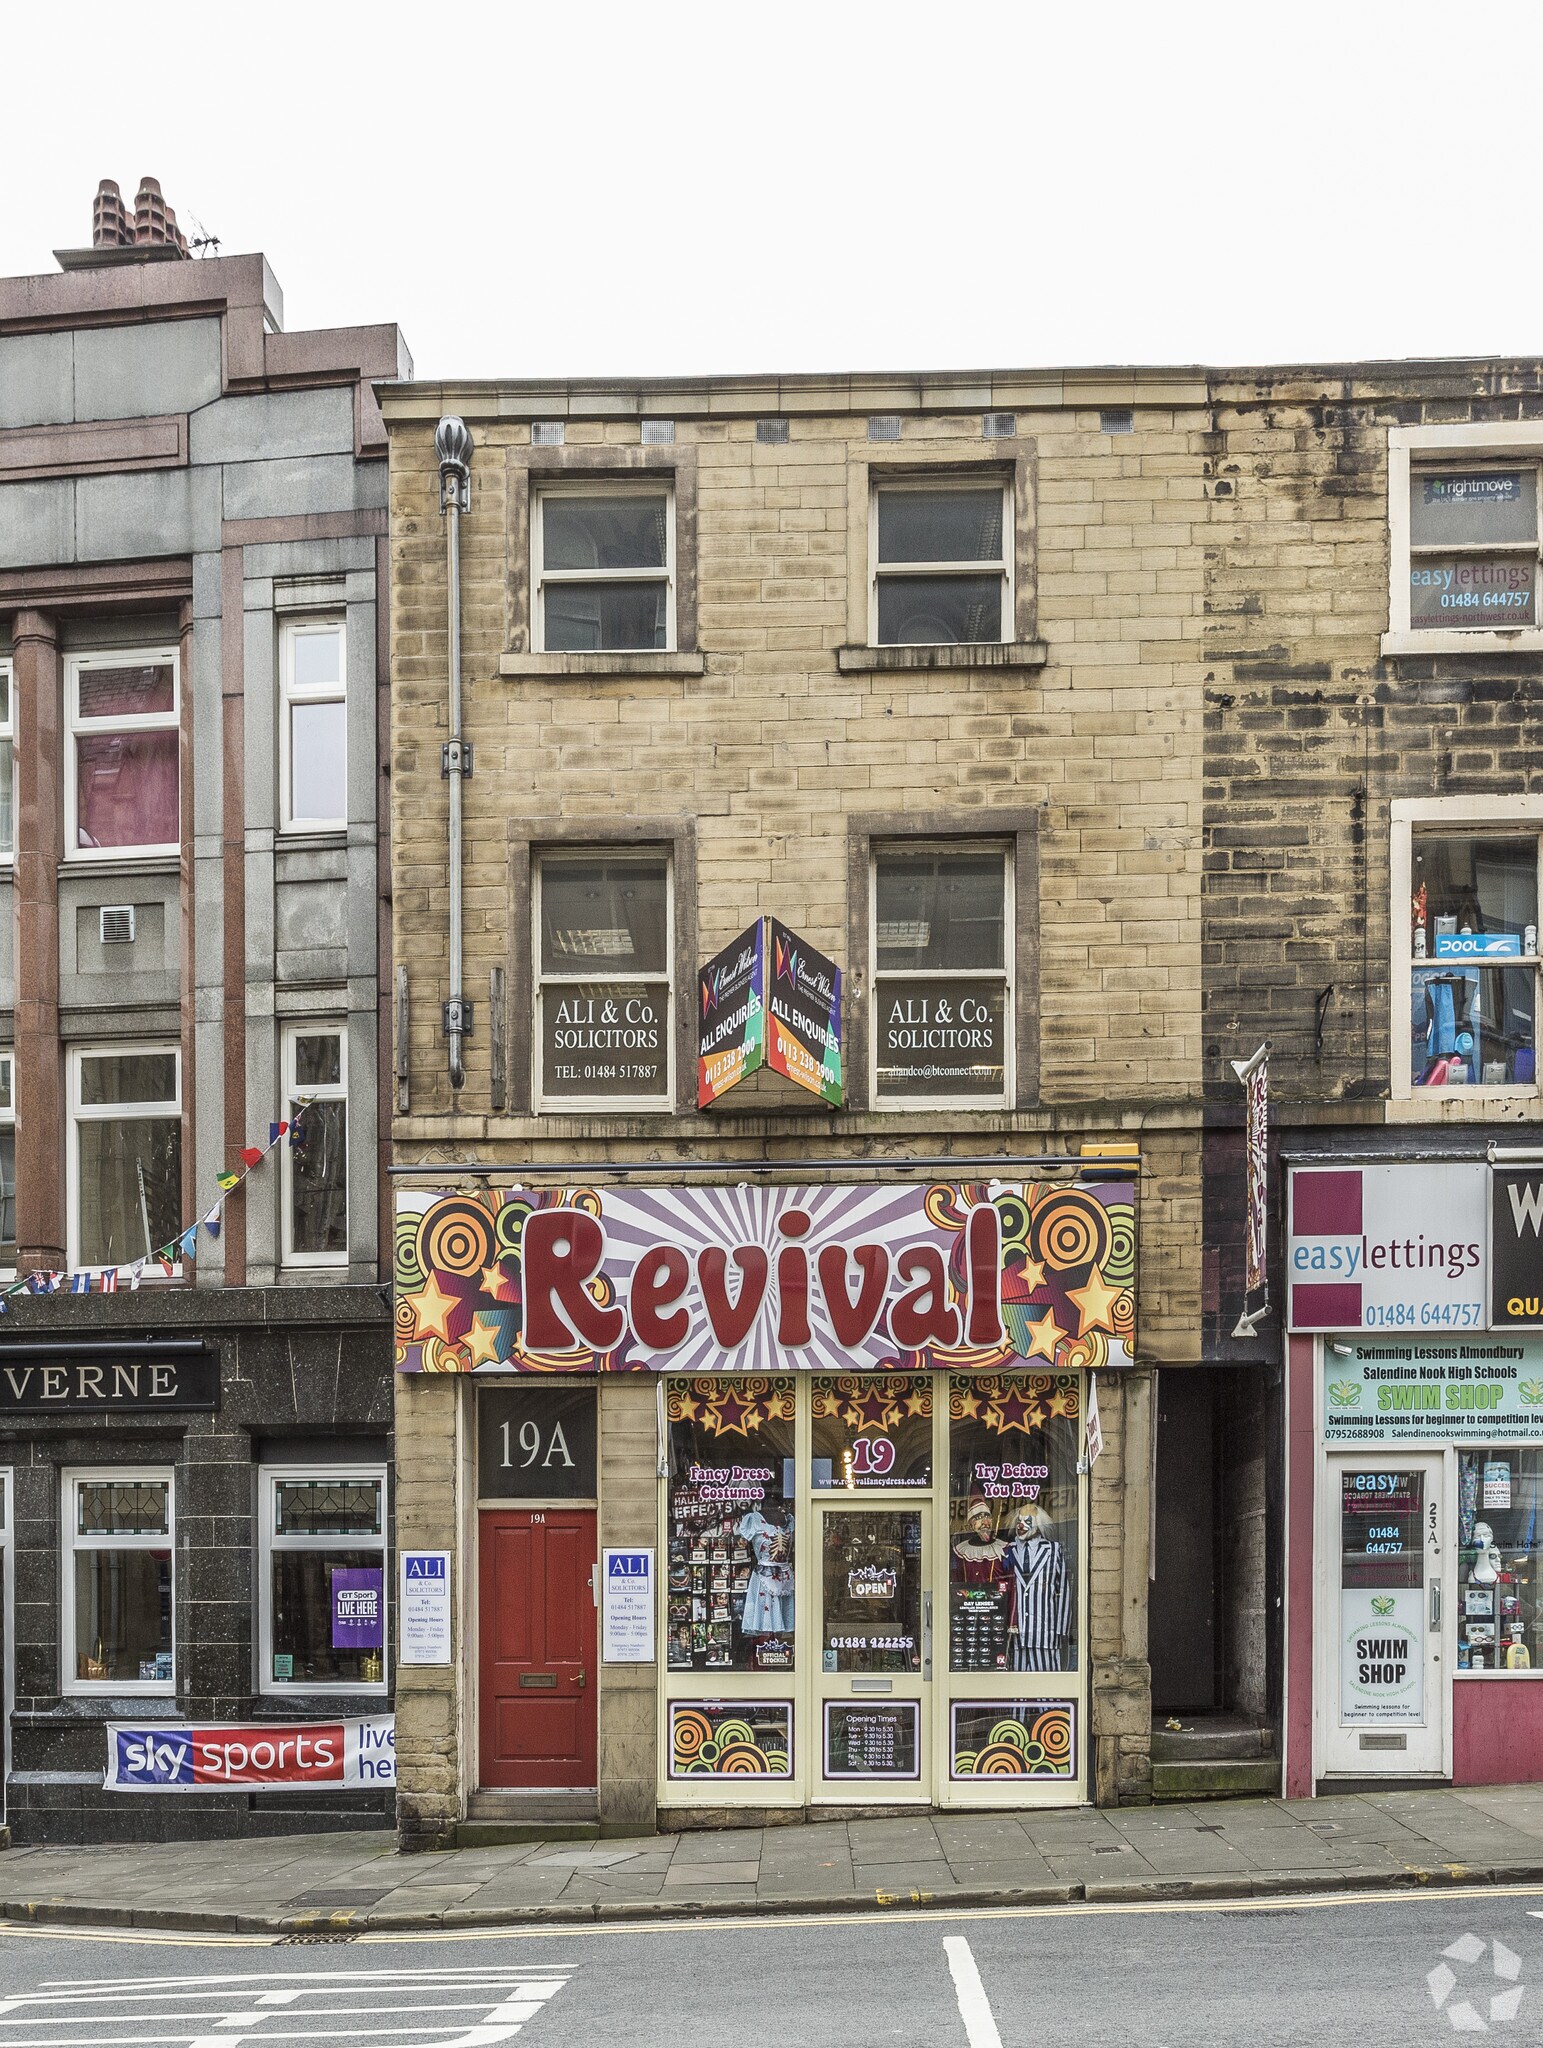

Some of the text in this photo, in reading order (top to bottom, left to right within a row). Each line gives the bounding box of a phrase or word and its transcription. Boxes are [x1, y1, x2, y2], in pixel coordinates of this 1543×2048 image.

[1447, 479, 1512, 497] rightmove
[1411, 563, 1530, 590] easylettings
[1441, 591, 1530, 608] 01484 644757
[1440, 940, 1484, 953] POOL
[797, 957, 836, 1003] Ernest Wilson
[555, 999, 658, 1024] ALI & Co.
[888, 998, 993, 1024] ALI & Co.
[700, 995, 762, 1056] ALL ENQUIRIES
[771, 997, 840, 1054] ALL ENQUIRIES
[554, 1029, 658, 1049] SOLICITORS
[888, 1029, 993, 1048] SOLICITORS
[705, 1036, 755, 1085] 0113 238 2900
[777, 1036, 835, 1085] 0113 238 2900
[554, 1065, 658, 1079] TEL: 01484 517887
[888, 1064, 992, 1080] aliandco@btconnect.com
[1293, 1234, 1480, 1279] easylettings
[523, 1204, 1005, 1351] Revival
[1366, 1303, 1481, 1327] 01484 644757
[1507, 1297, 1543, 1316] QU
[1356, 1346, 1524, 1361] Swimming Lessons Almondbury
[1363, 1365, 1517, 1380] Salendine Nook High Schools
[3, 1365, 178, 1399] VERNE
[1377, 1384, 1504, 1411] SWIM SHOP
[1328, 1415, 1373, 1426] Swimming
[1375, 1415, 1411, 1425] Lessons
[1411, 1415, 1424, 1425] for
[1426, 1414, 1465, 1425] beginner
[1466, 1415, 1475, 1424] to
[1477, 1413, 1530, 1425] competition
[1325, 1429, 1385, 1439] 07952688908
[500, 1420, 576, 1468] 19A
[852, 1438, 895, 1474] 19
[690, 1465, 770, 1483] Fancy Dress
[975, 1463, 1049, 1480] Try Before
[700, 1485, 765, 1500] Costumes
[983, 1482, 1039, 1499] You Buy
[1356, 1474, 1398, 1495] easy
[530, 1513, 546, 1524] 19A
[674, 1501, 733, 1519] EFFECTS
[1369, 1527, 1399, 1539] 01484
[1366, 1542, 1403, 1554] 644757
[1490, 1540, 1513, 1549] Swim
[408, 1560, 443, 1577] ALI
[611, 1557, 646, 1575] ALI
[354, 1591, 373, 1599] Sport
[855, 1582, 888, 1595] OPEN
[337, 1601, 378, 1614] LIVE HERE
[830, 1637, 913, 1649] 01484 422255
[1356, 1639, 1408, 1660] SWIM
[1359, 1663, 1406, 1684] SHOP
[846, 1715, 876, 1723] Opening
[358, 1723, 395, 1749] live
[125, 1734, 335, 1780] sky sports
